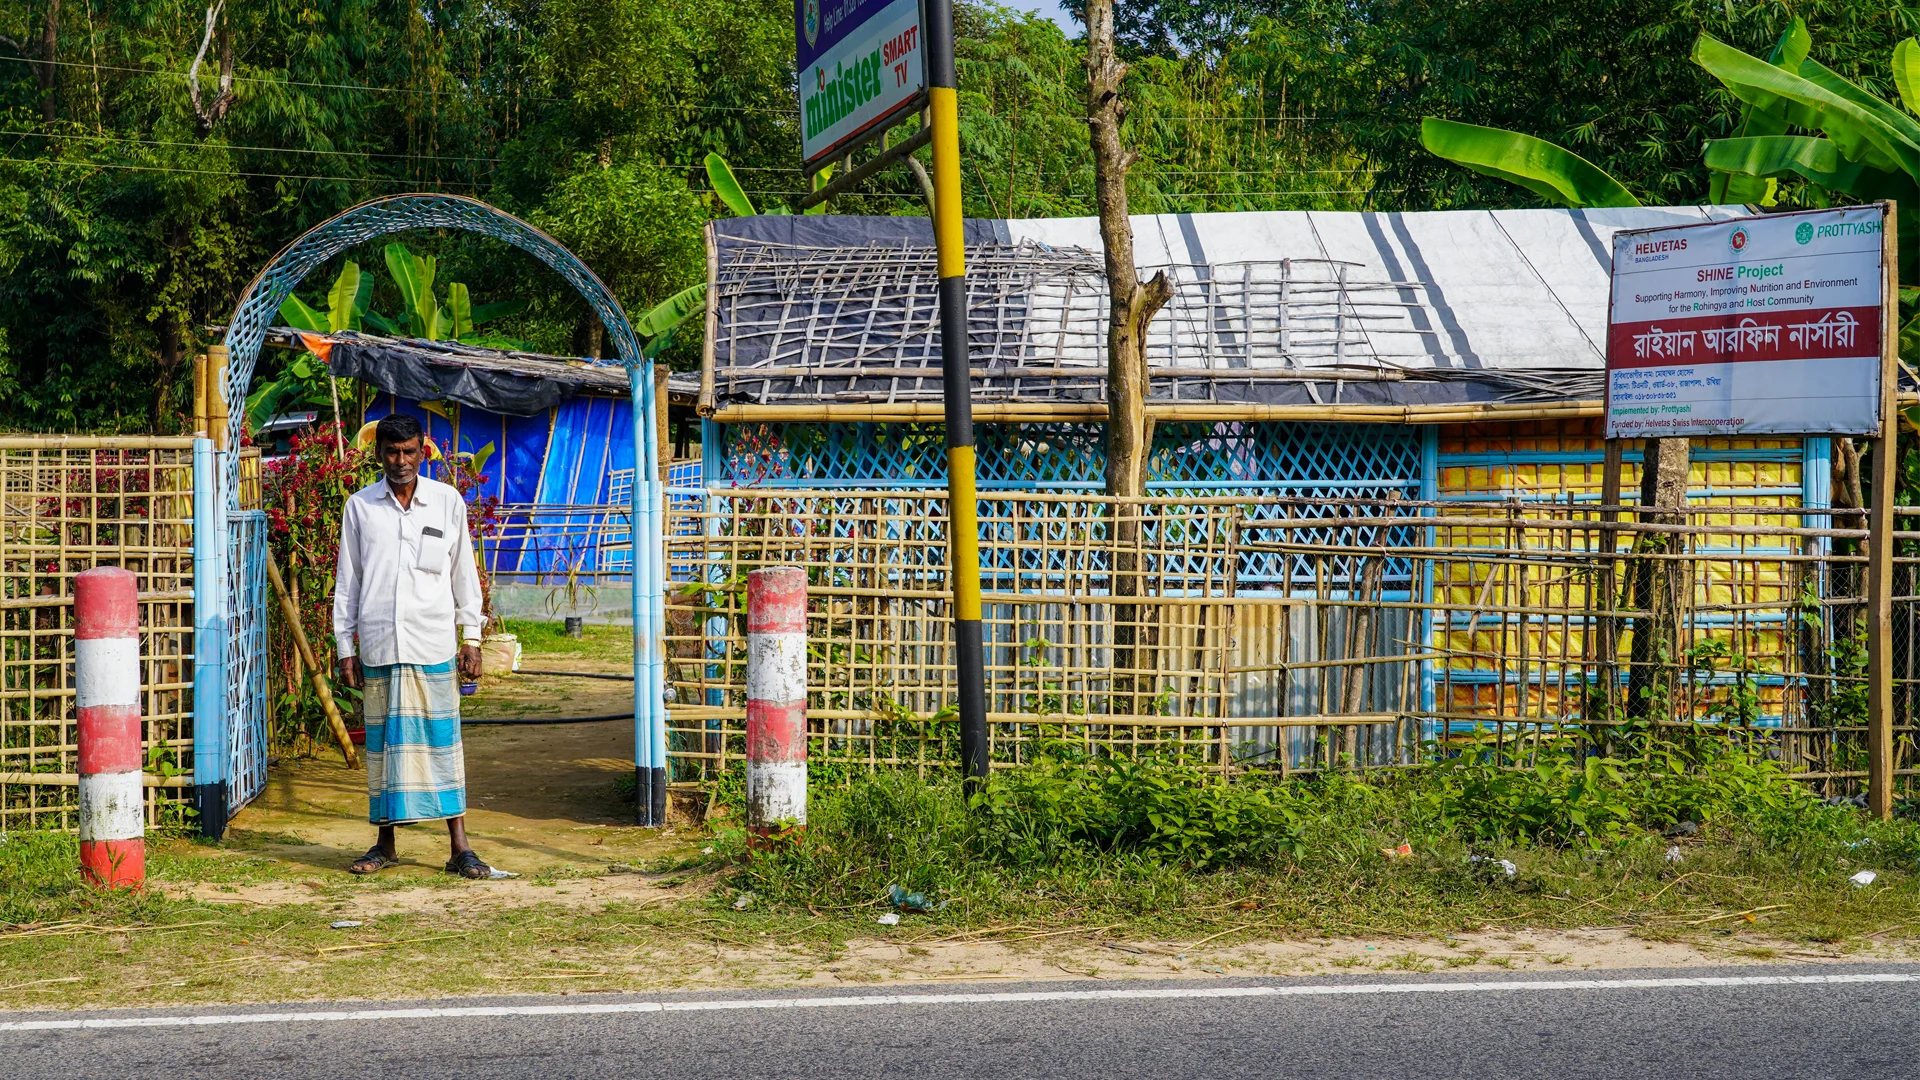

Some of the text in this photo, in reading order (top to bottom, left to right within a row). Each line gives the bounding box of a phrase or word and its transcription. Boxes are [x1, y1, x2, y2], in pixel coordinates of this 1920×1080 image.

[824, 11, 833, 34] Help
[883, 24, 918, 67] SMART
[894, 60, 908, 88] TV
[806, 48, 881, 141] minister
[1635, 239, 1687, 255] HELVETAS
[1635, 254, 1669, 263] BANGLADESH
[1697, 263, 1784, 282] SHINE Project
[1635, 277, 1858, 304] Supporting Harmony, Improving Nutrition and Environment
[1669, 294, 1814, 313] for the Rohingya and Host Community
[1632, 311, 1859, 359] রাইয়ান আরফিন নার্সারী
[1612, 404, 1692, 416] Implemented by: Prottyashi
[1611, 416, 1745, 429] Funded by: Helvetas Swiss Intercooperation
